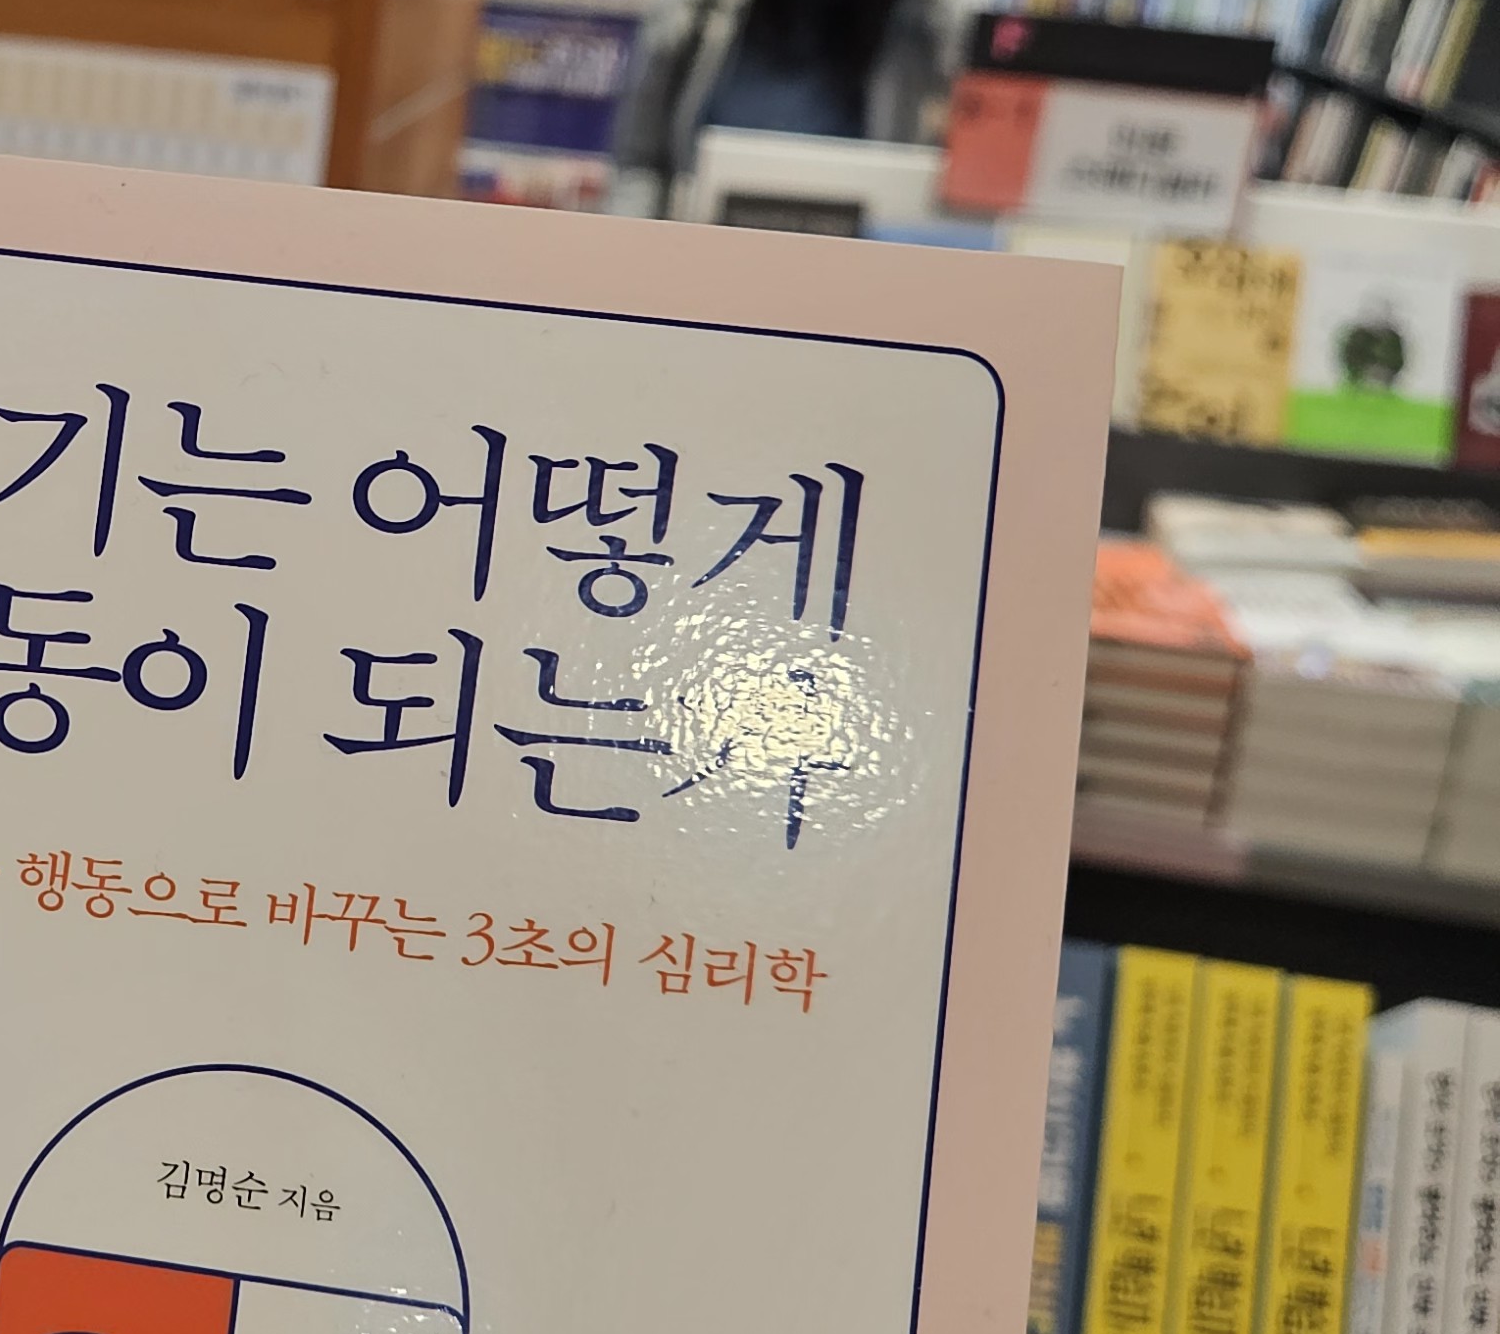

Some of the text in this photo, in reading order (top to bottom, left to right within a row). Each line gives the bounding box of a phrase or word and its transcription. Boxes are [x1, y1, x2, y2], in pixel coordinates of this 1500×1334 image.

[352, 424, 864, 643] 어떻게
[18, 851, 248, 931] 행동으로
[266, 883, 448, 961] 바꾸는
[463, 914, 614, 987] 3초의
[639, 932, 828, 1014] 심리학
[156, 1159, 342, 1222] 김명순 지음
